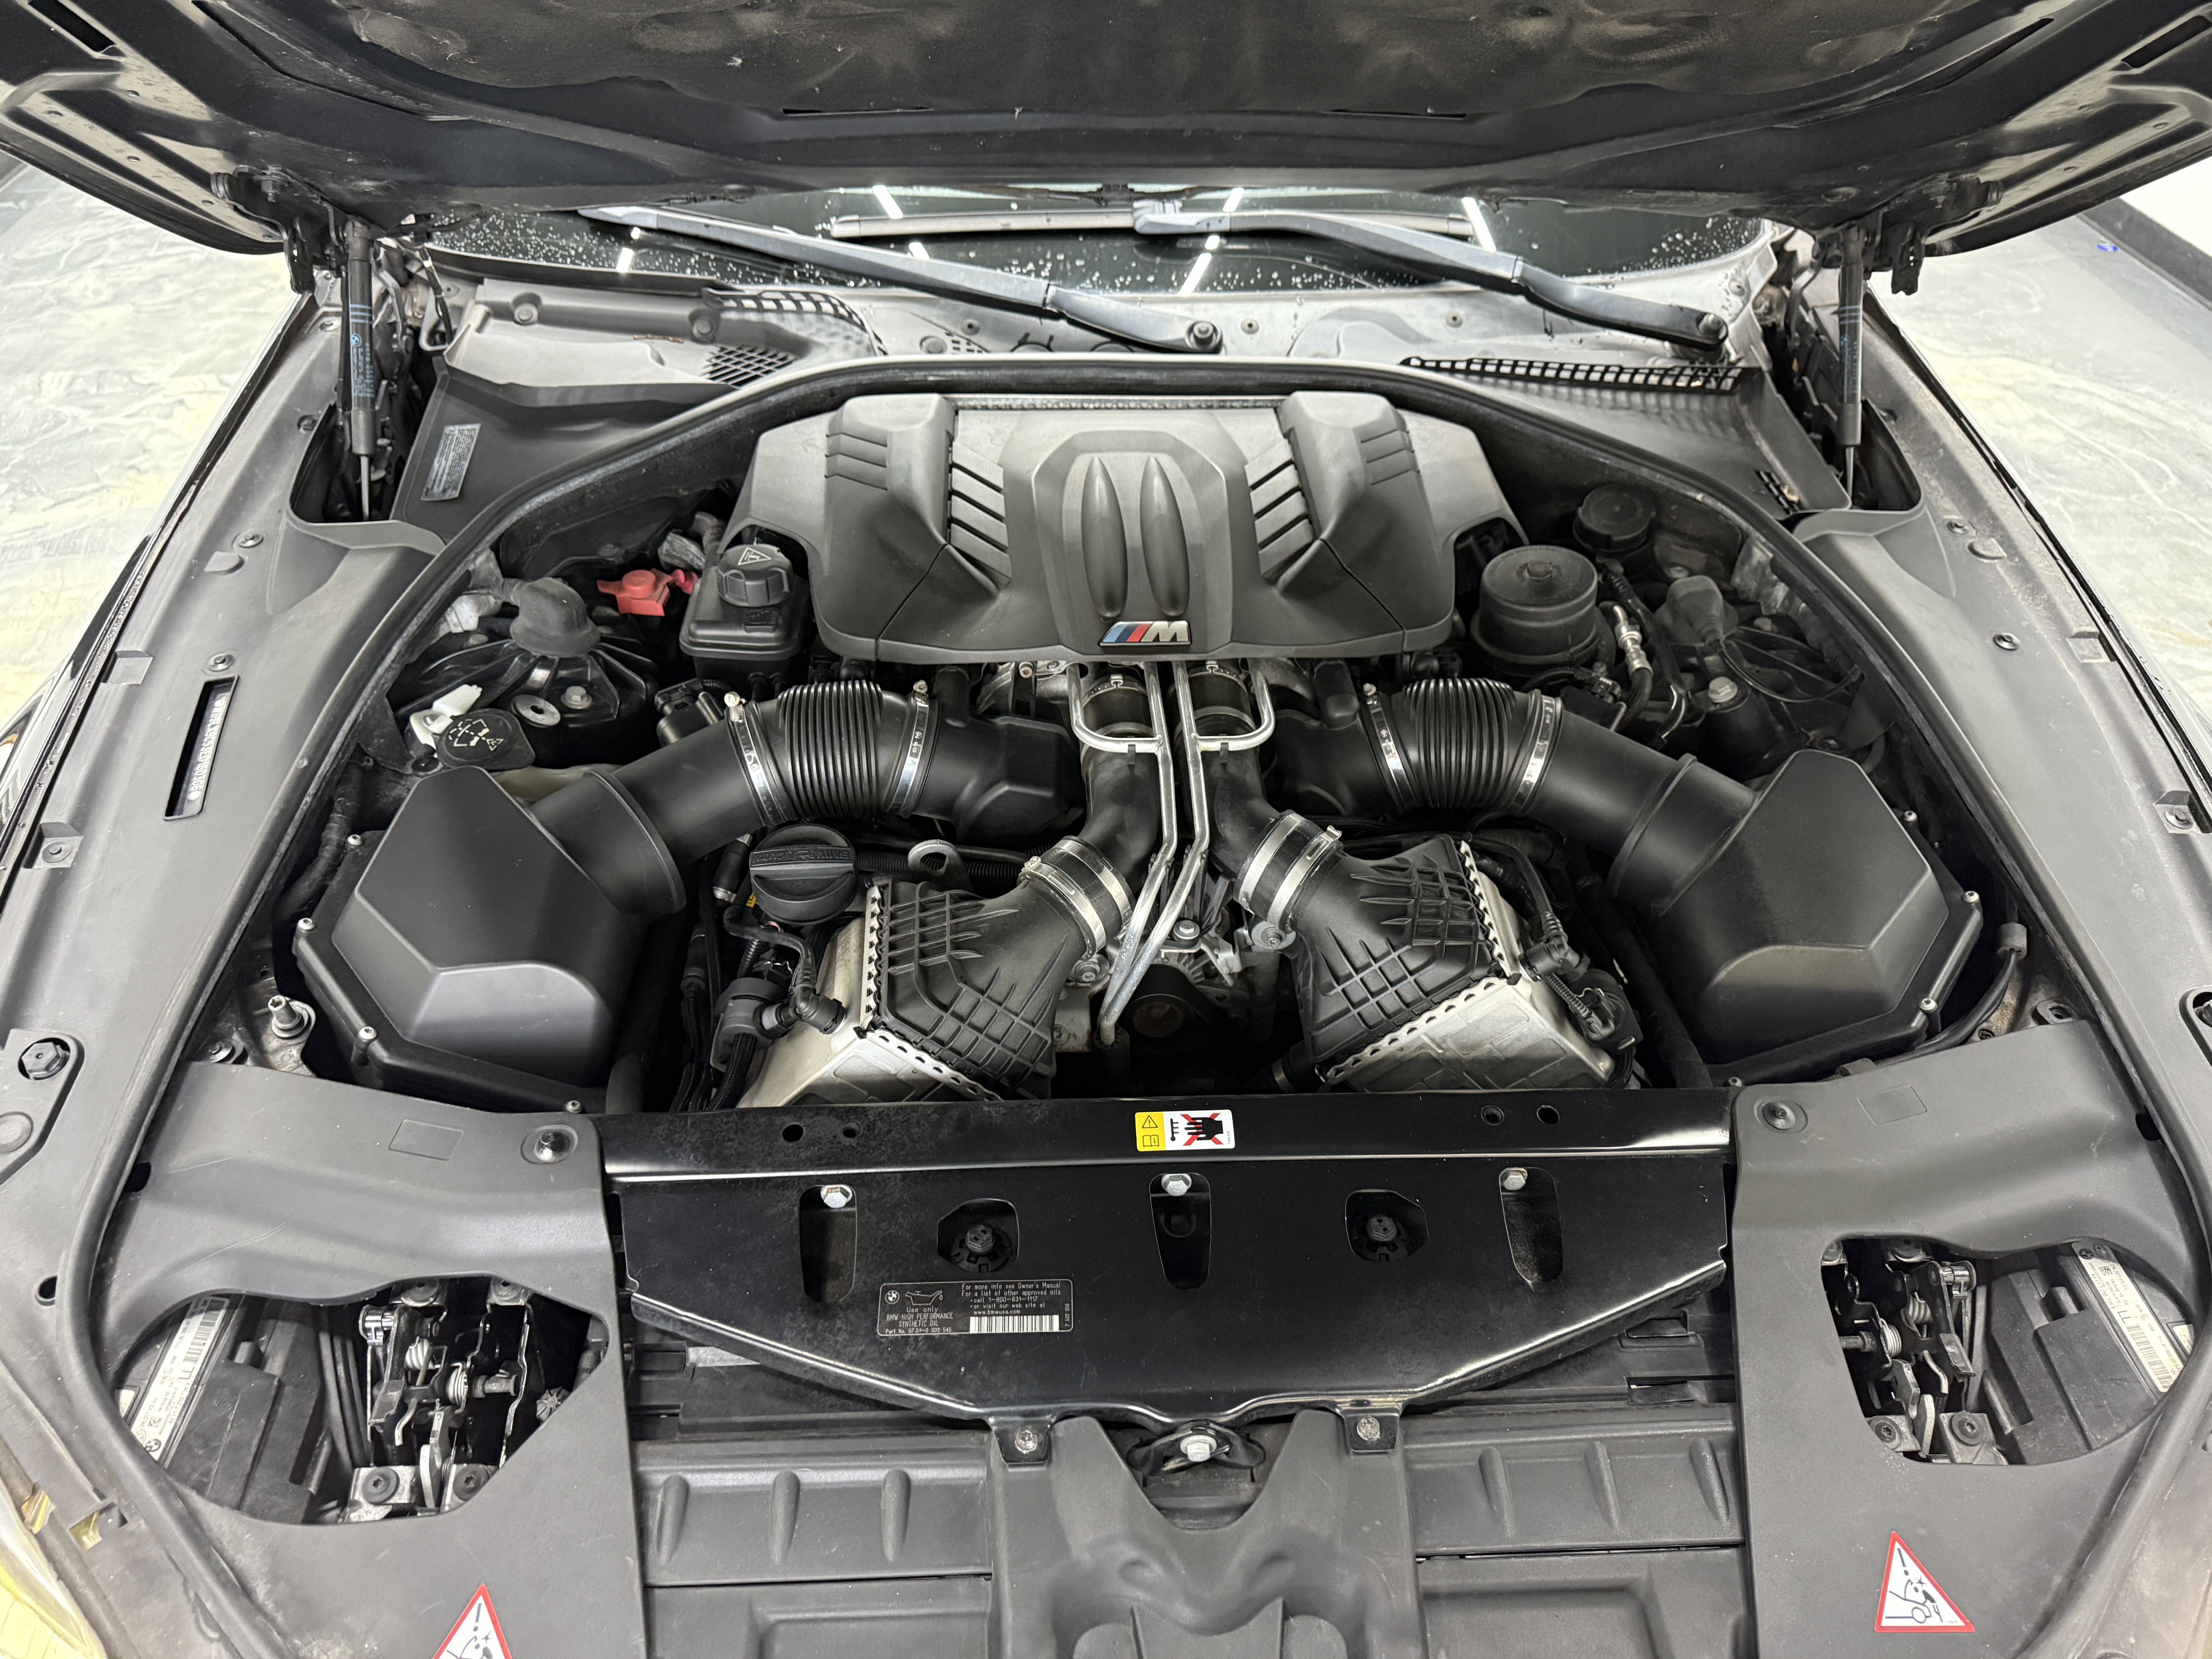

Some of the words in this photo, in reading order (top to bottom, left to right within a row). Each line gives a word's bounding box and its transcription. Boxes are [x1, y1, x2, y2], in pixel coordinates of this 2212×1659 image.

[1022, 1290, 1047, 1298] approved
[923, 1305, 938, 1314] only
[916, 1312, 953, 1321] PERFORMANCE
